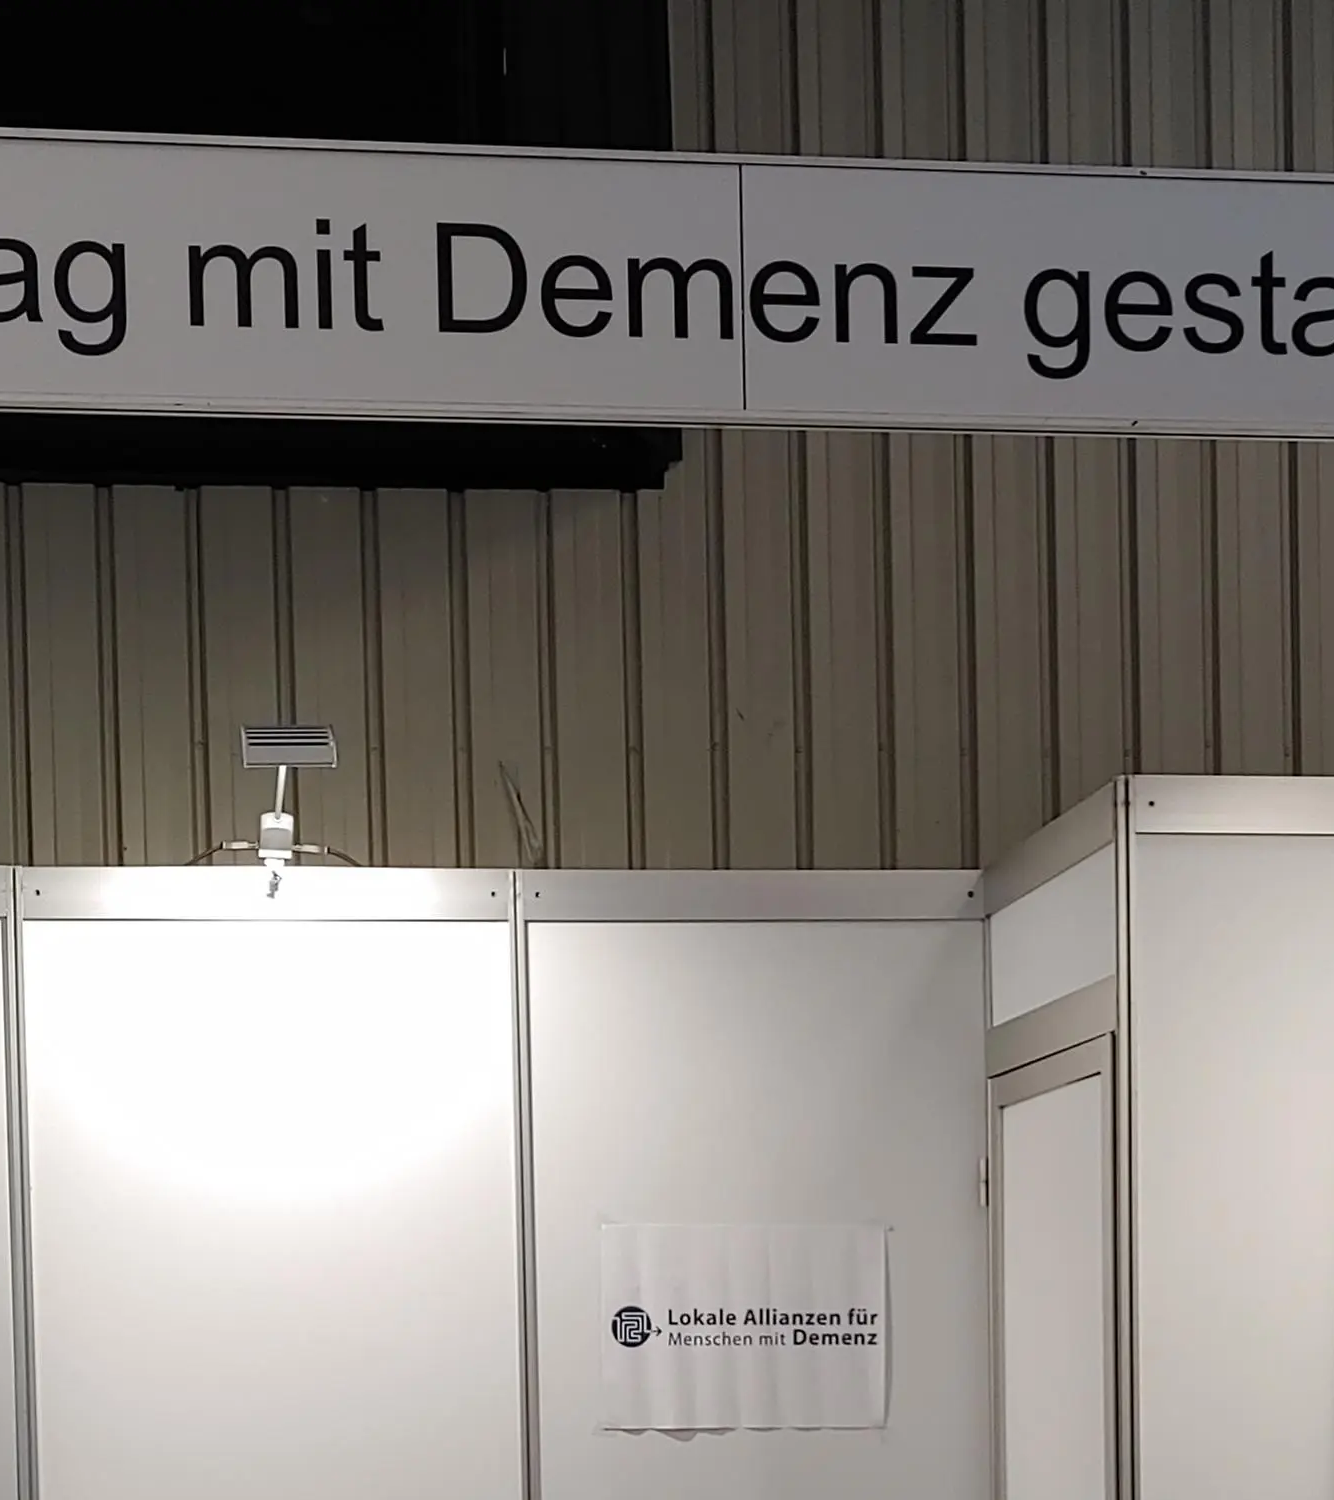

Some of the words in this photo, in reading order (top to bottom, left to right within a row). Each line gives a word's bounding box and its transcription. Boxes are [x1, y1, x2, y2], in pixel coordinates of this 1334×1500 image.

[185, 216, 384, 334] mit
[438, 222, 976, 347] Demenz
[668, 1308, 736, 1326] Lokale
[744, 1308, 841, 1326] Allianzen
[848, 1308, 878, 1326] für
[668, 1331, 752, 1346] Menschen
[759, 1331, 786, 1346] mit
[792, 1329, 878, 1346] Demenz
